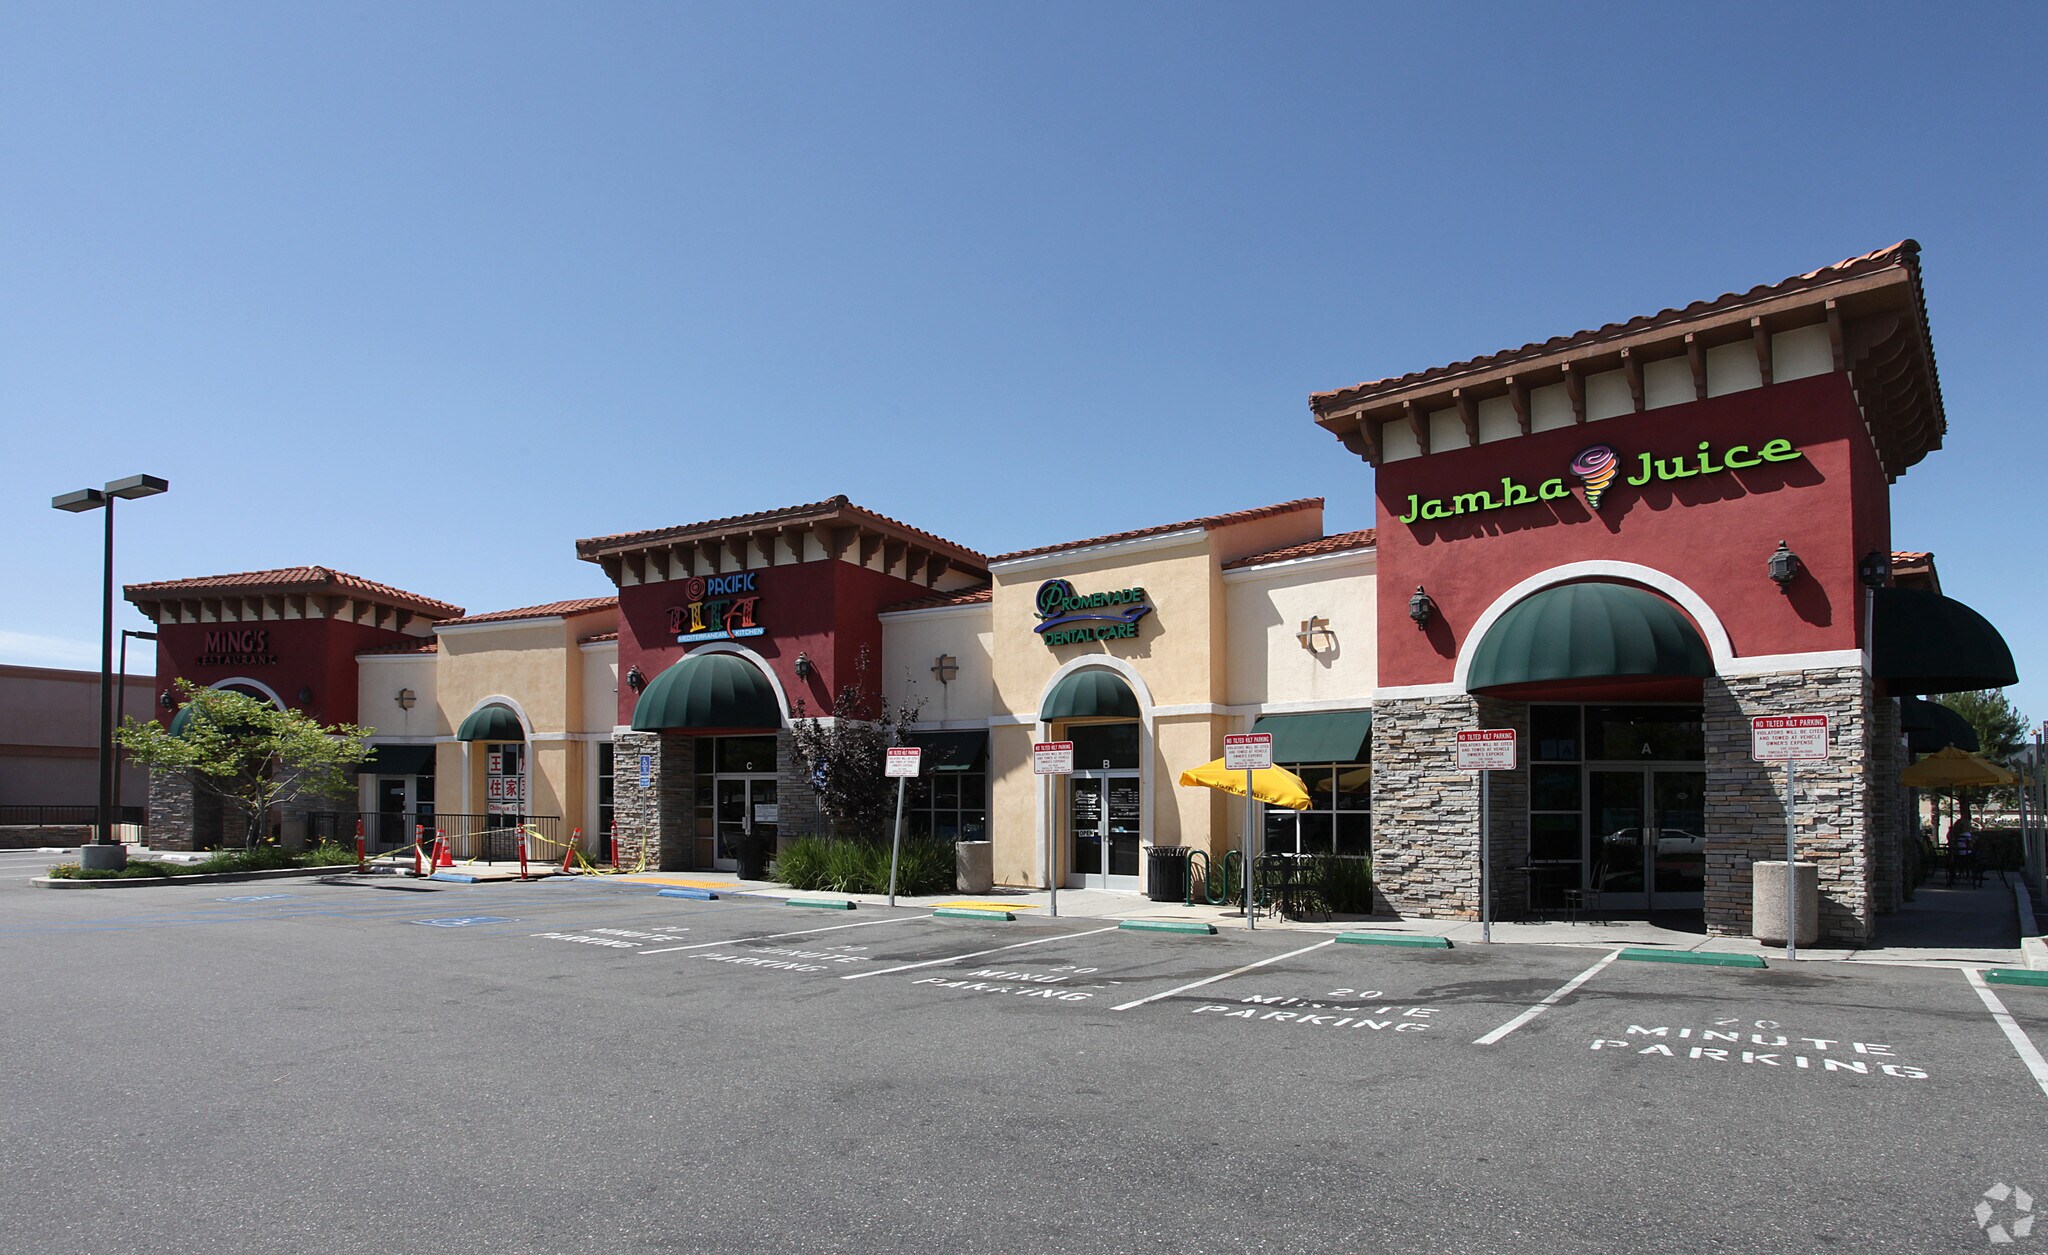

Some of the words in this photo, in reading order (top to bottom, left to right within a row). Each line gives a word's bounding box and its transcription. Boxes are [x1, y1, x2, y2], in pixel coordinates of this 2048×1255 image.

[1399, 477, 1570, 524] Jamba
[1627, 437, 1802, 486] Juice
[708, 572, 754, 596] PACIFIC
[1036, 579, 1144, 618] PROMENADE
[666, 596, 760, 639] PITA
[735, 628, 763, 636] KITCHEN
[1044, 627, 1092, 646] DENTAL
[1096, 622, 1138, 640] CARE
[1642, 743, 1651, 754] A
[490, 756, 501, 771] 王
[746, 762, 752, 770] C
[1103, 760, 1110, 768] B
[490, 779, 524, 796] 住家
[689, 953, 828, 972] PARKING
[750, 948, 869, 963] MINUTE
[1050, 966, 1098, 974] 20
[1328, 988, 1383, 998] 20
[1192, 1005, 1430, 1031] PARKING
[1714, 1018, 1780, 1030] 20
[1626, 1024, 1896, 1056] MINUTE
[1590, 1039, 1929, 1079] PARKING
